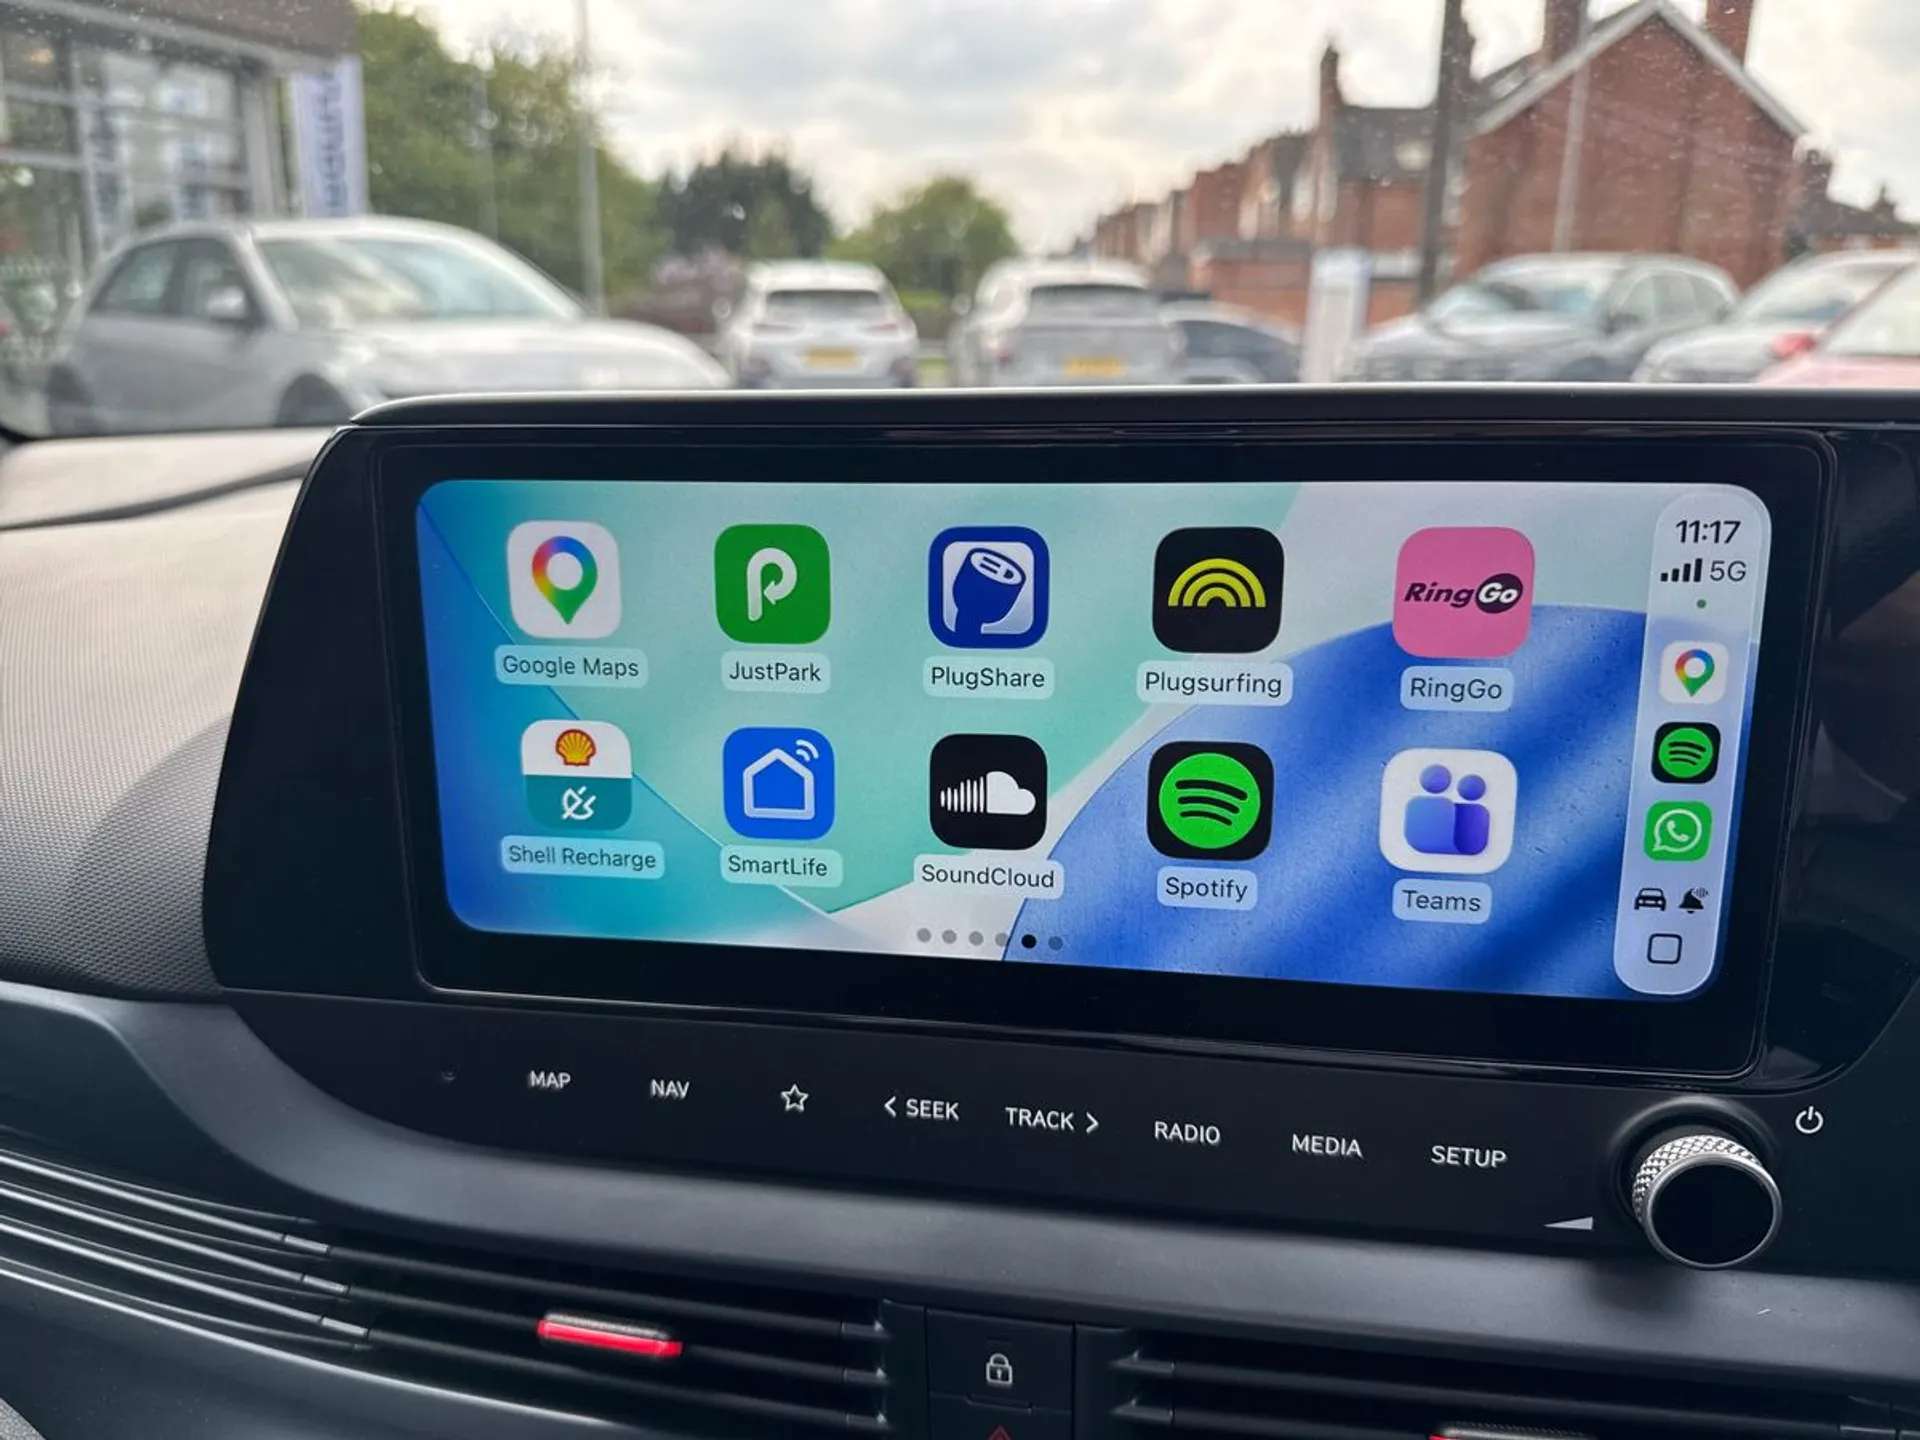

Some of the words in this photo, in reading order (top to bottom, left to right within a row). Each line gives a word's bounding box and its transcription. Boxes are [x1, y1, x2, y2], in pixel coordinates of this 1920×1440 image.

[1674, 520, 1741, 545] 11:17
[1709, 561, 1747, 583] 5G
[502, 656, 576, 679] Google
[584, 658, 639, 681] Maps
[728, 661, 822, 684] JustPark
[930, 666, 1046, 691] PlugShare
[1144, 672, 1282, 698] Plugsurfing
[1410, 677, 1503, 702] RingGo
[508, 846, 556, 865] Shell
[562, 849, 656, 871] Recharge
[728, 855, 829, 878] SmartLife
[921, 864, 1055, 889] SoundCloud
[1165, 876, 1249, 903] Spotify
[1403, 890, 1482, 913] Teams
[528, 1070, 572, 1090] MAP
[651, 1079, 690, 1099] NAV
[905, 1098, 960, 1121] SEEK
[1005, 1106, 1075, 1131] TRACK
[1154, 1121, 1221, 1146] RADIO
[1292, 1134, 1364, 1159] MEDIA
[1431, 1145, 1507, 1169] SETUP
